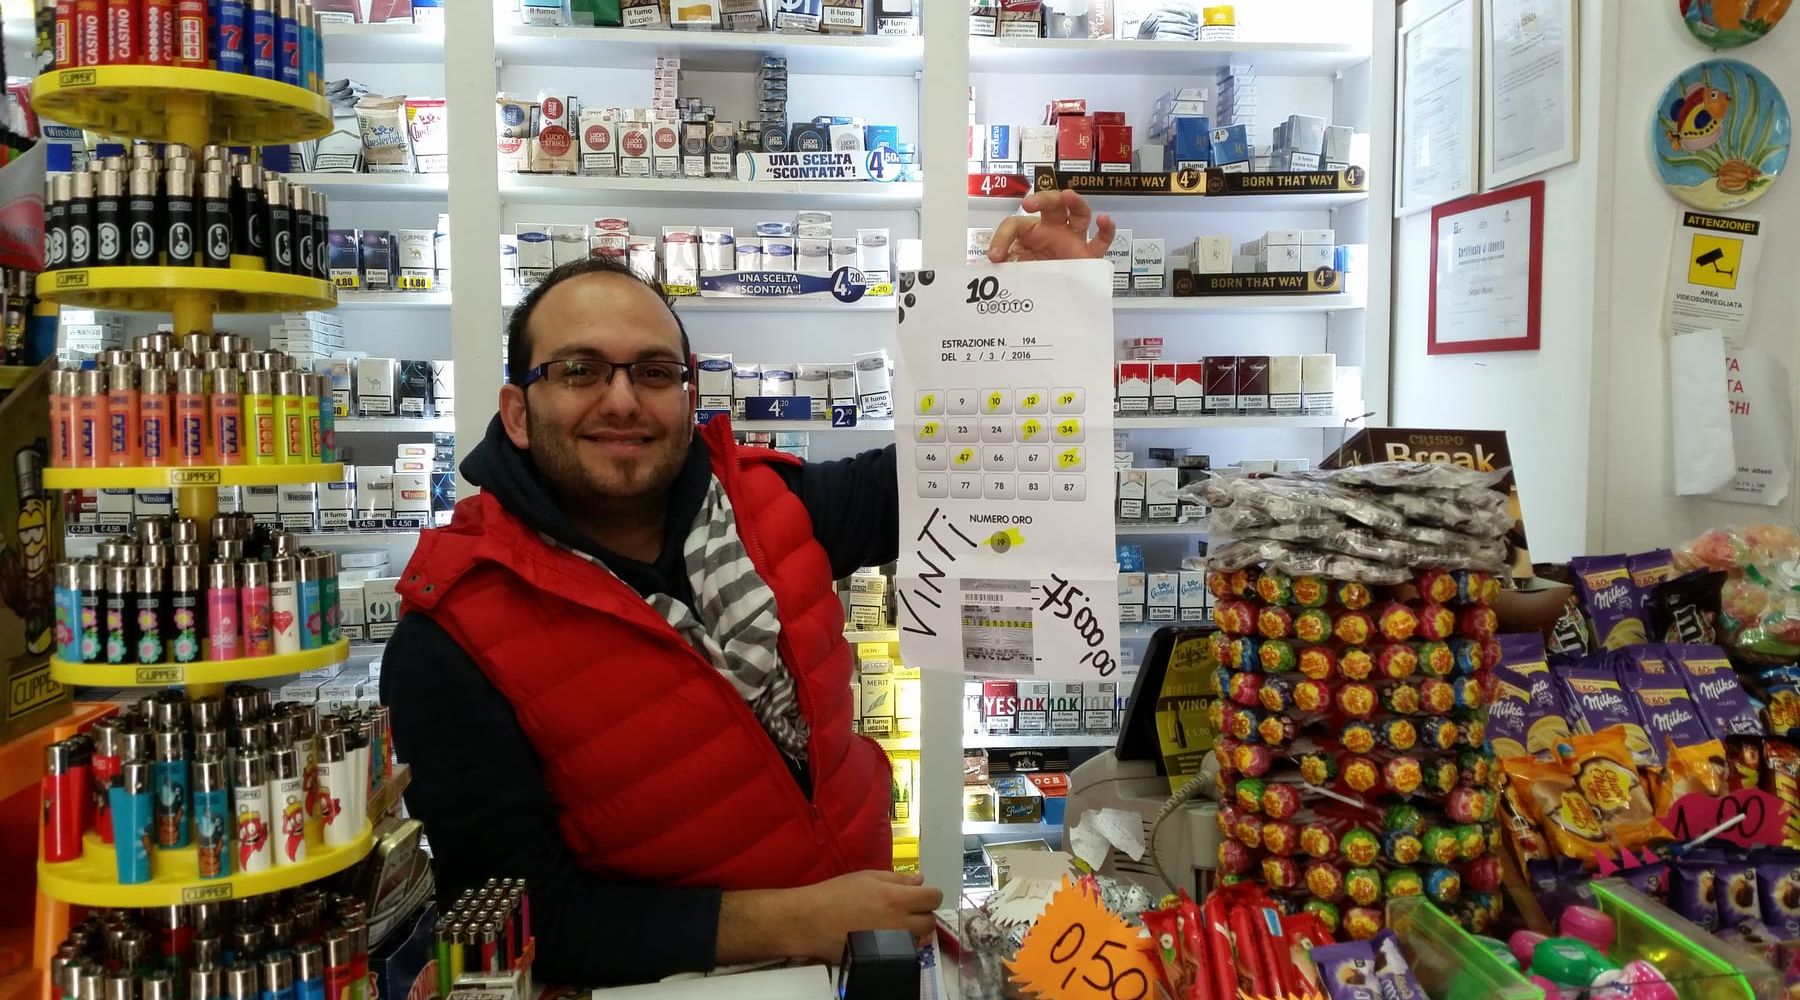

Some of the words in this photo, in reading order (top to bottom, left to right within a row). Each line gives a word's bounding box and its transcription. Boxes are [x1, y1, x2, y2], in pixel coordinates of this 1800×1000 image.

[636, 7, 653, 16] fumo
[837, 9, 855, 17] fumo
[831, 16, 855, 24] uccide
[118, 8, 130, 58] CASINO
[163, 12, 173, 60] CASINO
[221, 24, 243, 51] 7
[86, 15, 99, 65] CASINO
[255, 34, 273, 59] 7
[48, 127, 80, 138] Winston
[362, 130, 404, 150] Chesterfield
[769, 155, 799, 166] UNA
[803, 153, 853, 165] SCELTA
[981, 176, 1007, 195] 4,20
[1073, 175, 1104, 187] BORN
[1109, 176, 1137, 187] THAT
[1145, 177, 1166, 187] WAY
[1242, 176, 1274, 187] BORN
[1277, 175, 1309, 187] THAT
[1309, 174, 1334, 185] WAY
[1688, 215, 1756, 232] ATTENZIONE!
[738, 274, 760, 283] UNA
[763, 274, 798, 283] SCELTA
[1211, 276, 1243, 288] BORN
[1246, 276, 1277, 288] THAT
[1278, 275, 1304, 287] WAY
[1700, 289, 1719, 298] AREA
[977, 299, 1034, 314] LOTTO
[1676, 293, 1743, 309] VIDEOSORVEGLIATA
[942, 338, 996, 349] ESTRAZIONE
[998, 338, 1008, 347] N.
[1022, 337, 1036, 345] 194
[941, 353, 957, 362] DEL
[966, 353, 971, 361] 2
[989, 353, 994, 361] 3
[1012, 351, 1031, 360] 2016
[960, 398, 965, 406] 9
[992, 397, 1000, 405] 10
[1027, 397, 1036, 405] 12
[1063, 396, 1072, 404] 19
[769, 400, 781, 417] 4
[925, 426, 934, 434] 21
[958, 426, 968, 434] 23
[992, 426, 1002, 434] 24
[1027, 425, 1036, 434] 31
[1063, 425, 1073, 433] 34
[926, 453, 936, 461] 46
[960, 453, 970, 461] 47
[994, 453, 1004, 462] 66
[1028, 453, 1038, 462] 67
[1064, 453, 1074, 462] 72
[1385, 443, 1496, 473] Break
[174, 470, 217, 481] CLIPPER
[927, 481, 937, 489] 76
[961, 481, 970, 489] 77
[995, 481, 1004, 490] 78
[1029, 482, 1039, 491] 83
[1064, 483, 1074, 491] 87
[970, 515, 1010, 524] NUMERO
[1012, 515, 1033, 524] ORO
[996, 538, 1005, 546] 19
[1594, 585, 1629, 611] Milka
[140, 670, 178, 681] CLIPPER
[1699, 678, 1738, 700] Milka
[985, 697, 1016, 716] YES
[1178, 699, 1208, 711] VINO
[1583, 693, 1623, 711] Milka
[1489, 700, 1525, 718] Milka
[1653, 709, 1693, 733] Milka
[1034, 777, 1061, 785] OCB
[187, 887, 229, 900] CLIPPER
[1050, 923, 1149, 1000] 0,50
